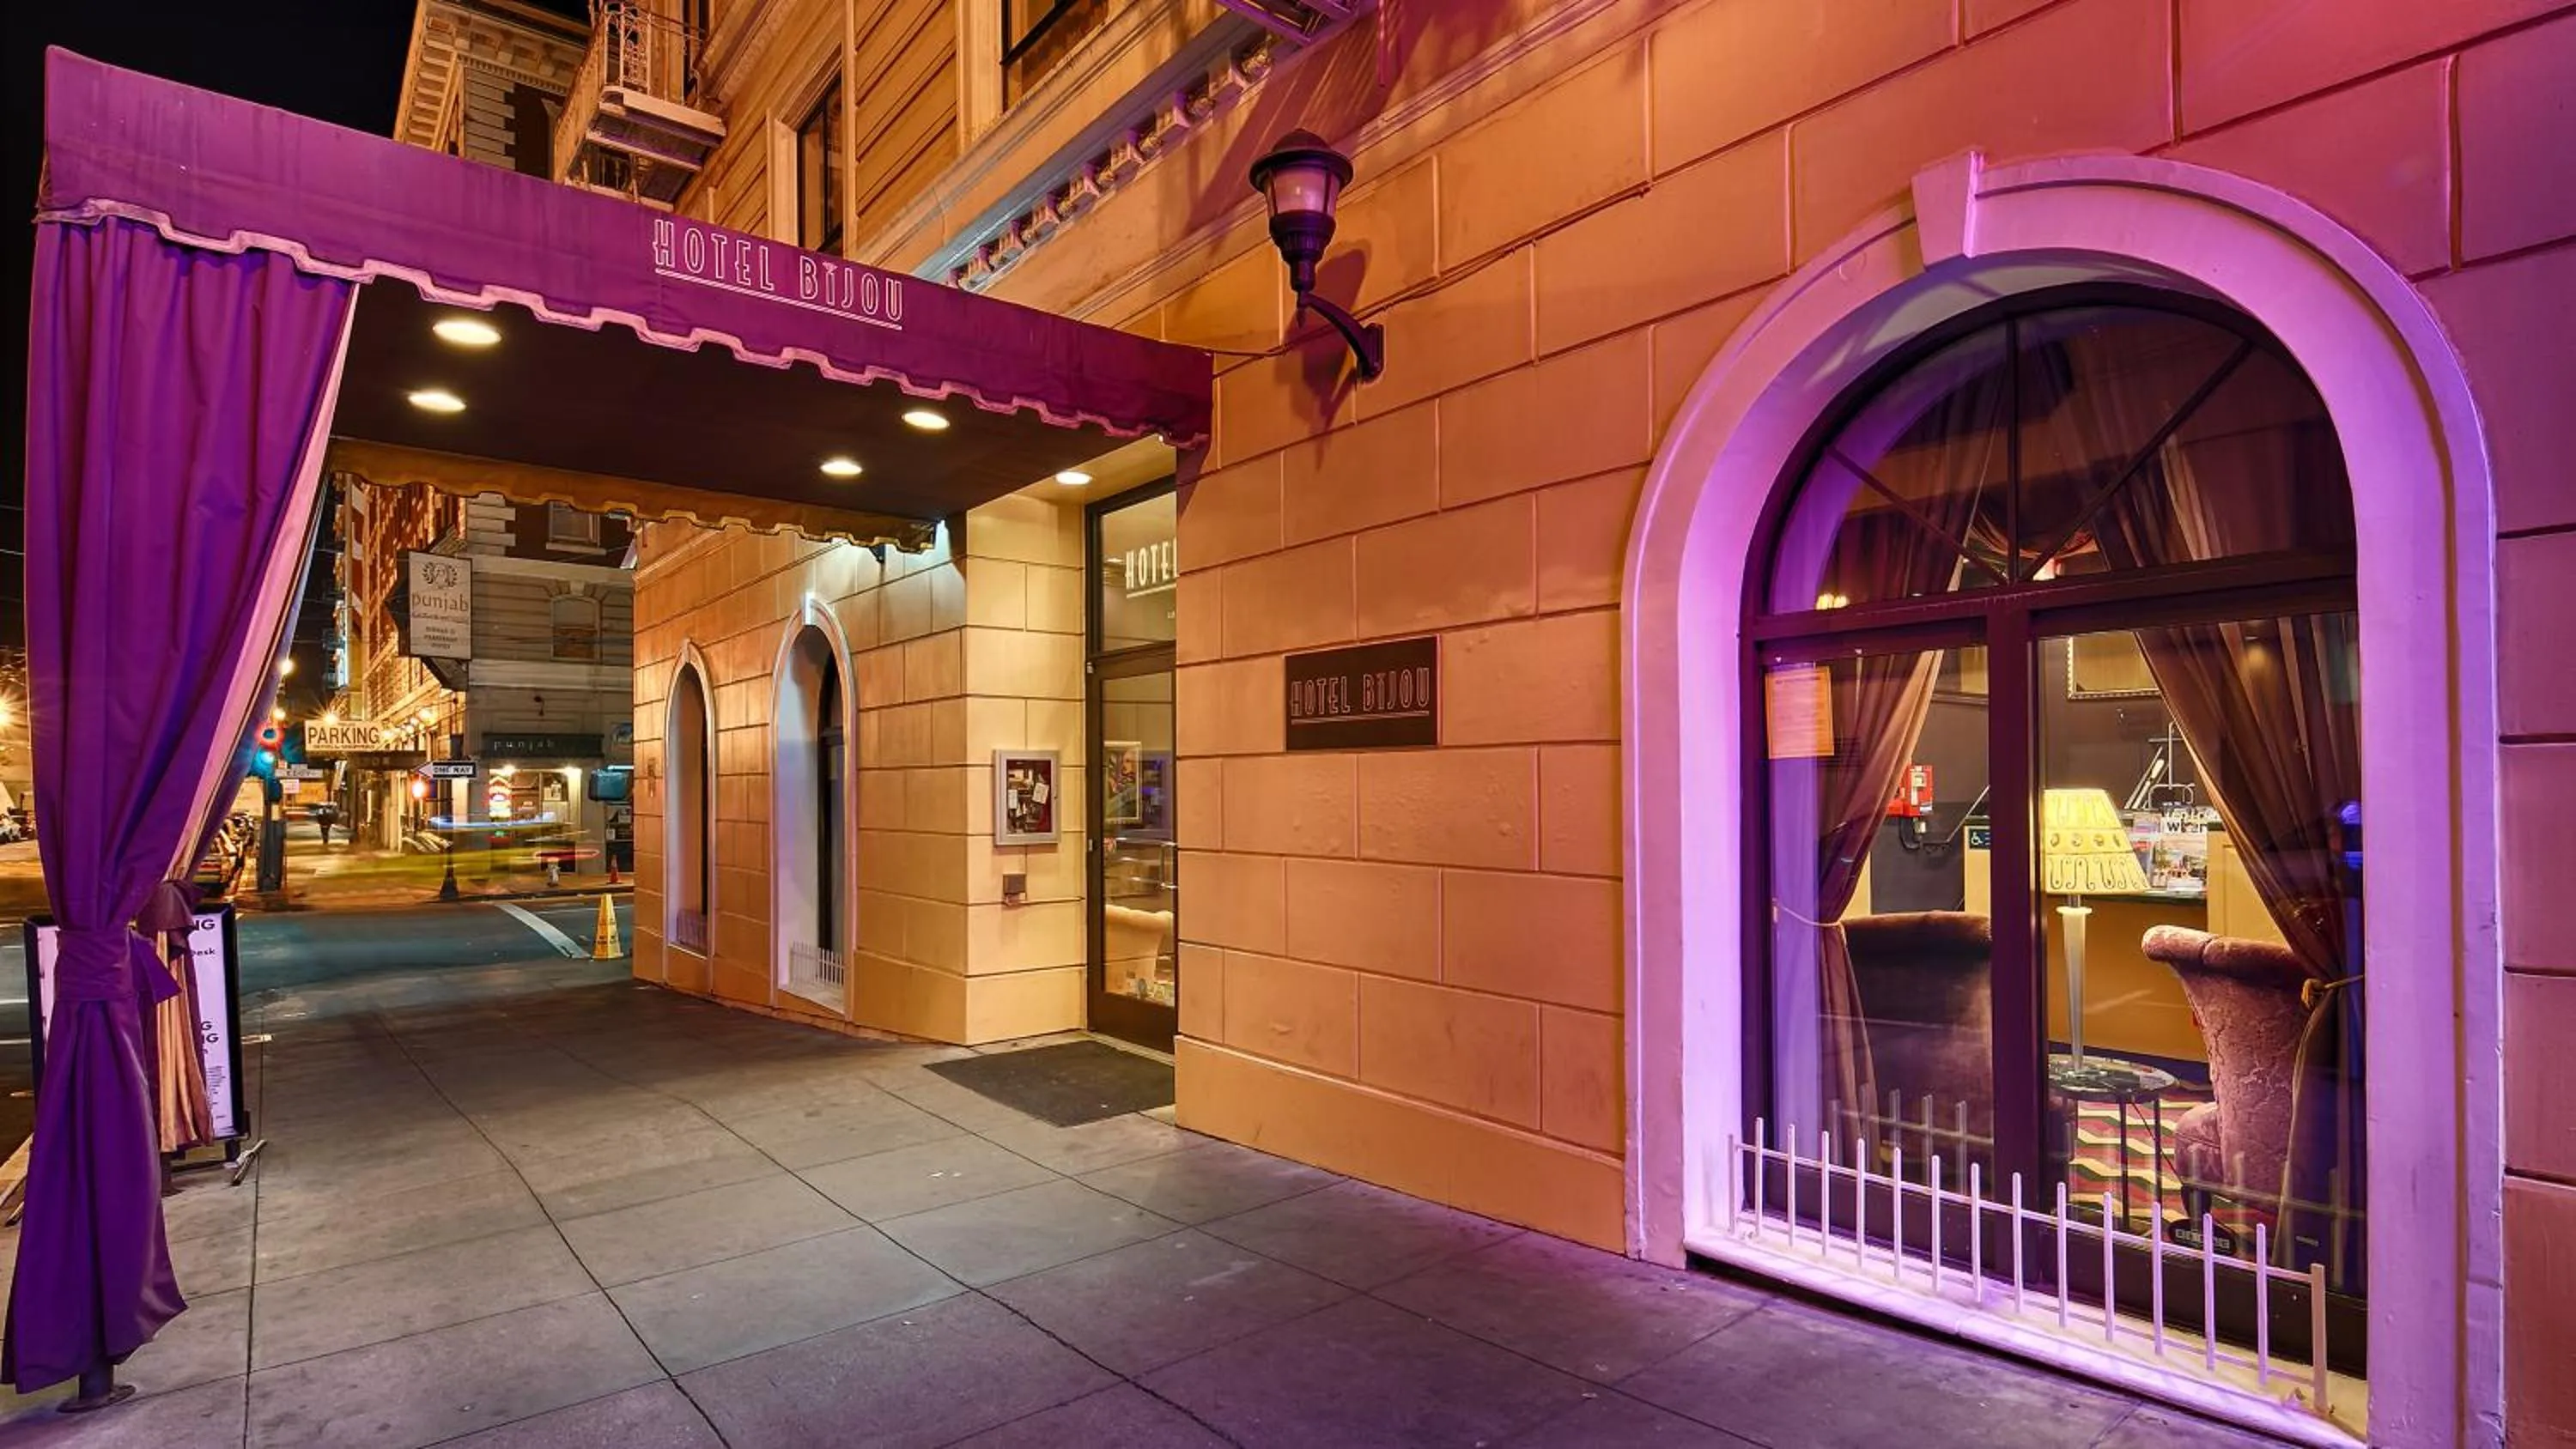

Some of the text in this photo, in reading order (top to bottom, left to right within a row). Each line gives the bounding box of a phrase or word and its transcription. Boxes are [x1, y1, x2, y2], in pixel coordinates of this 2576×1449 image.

[653, 219, 902, 321] HOTEL BIJOU
[411, 591, 470, 613] punjab
[1290, 667, 1430, 718] HOTEL BIJOU
[307, 726, 380, 745] PARKING
[493, 739, 556, 751] punjab
